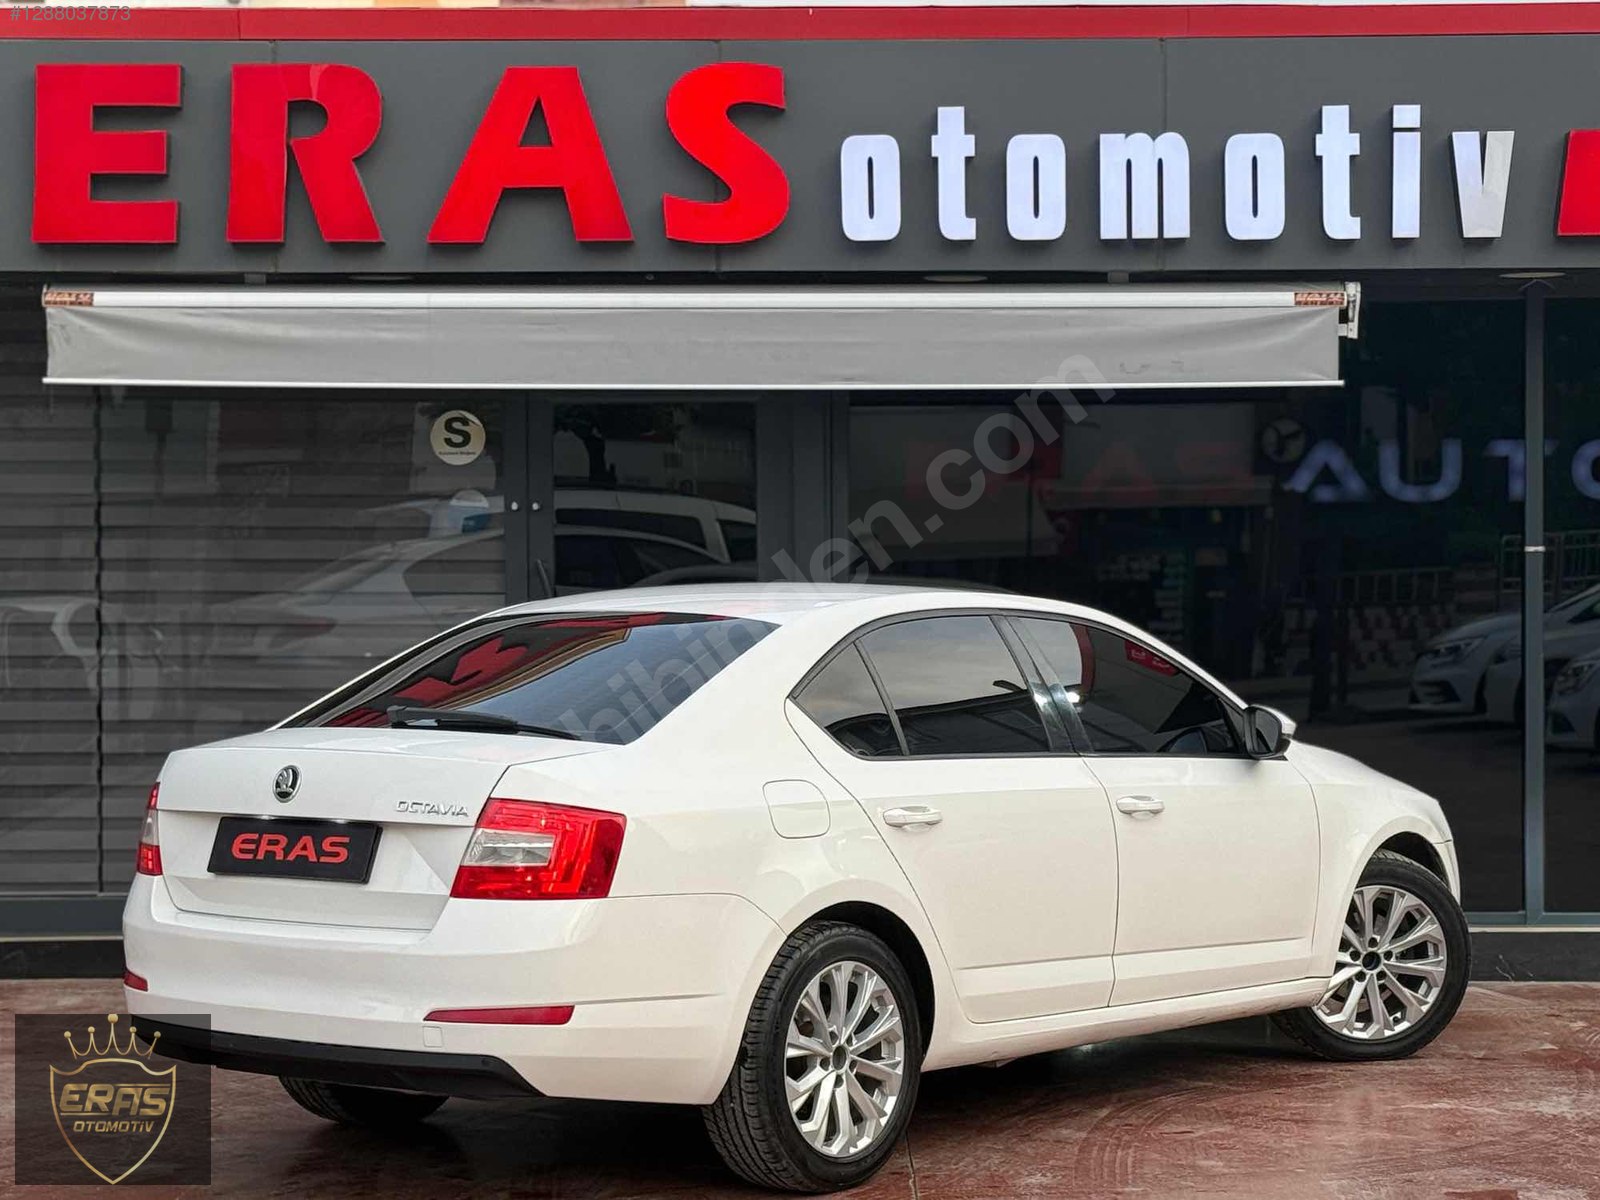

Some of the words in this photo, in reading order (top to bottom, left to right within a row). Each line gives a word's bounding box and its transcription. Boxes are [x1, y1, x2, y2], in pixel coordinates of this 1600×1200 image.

[32, 62, 790, 244] ERAS
[840, 104, 1514, 241] otomotiv
[444, 417, 471, 448] S
[395, 800, 469, 817] OCTAVIA
[231, 832, 351, 864] ERAS
